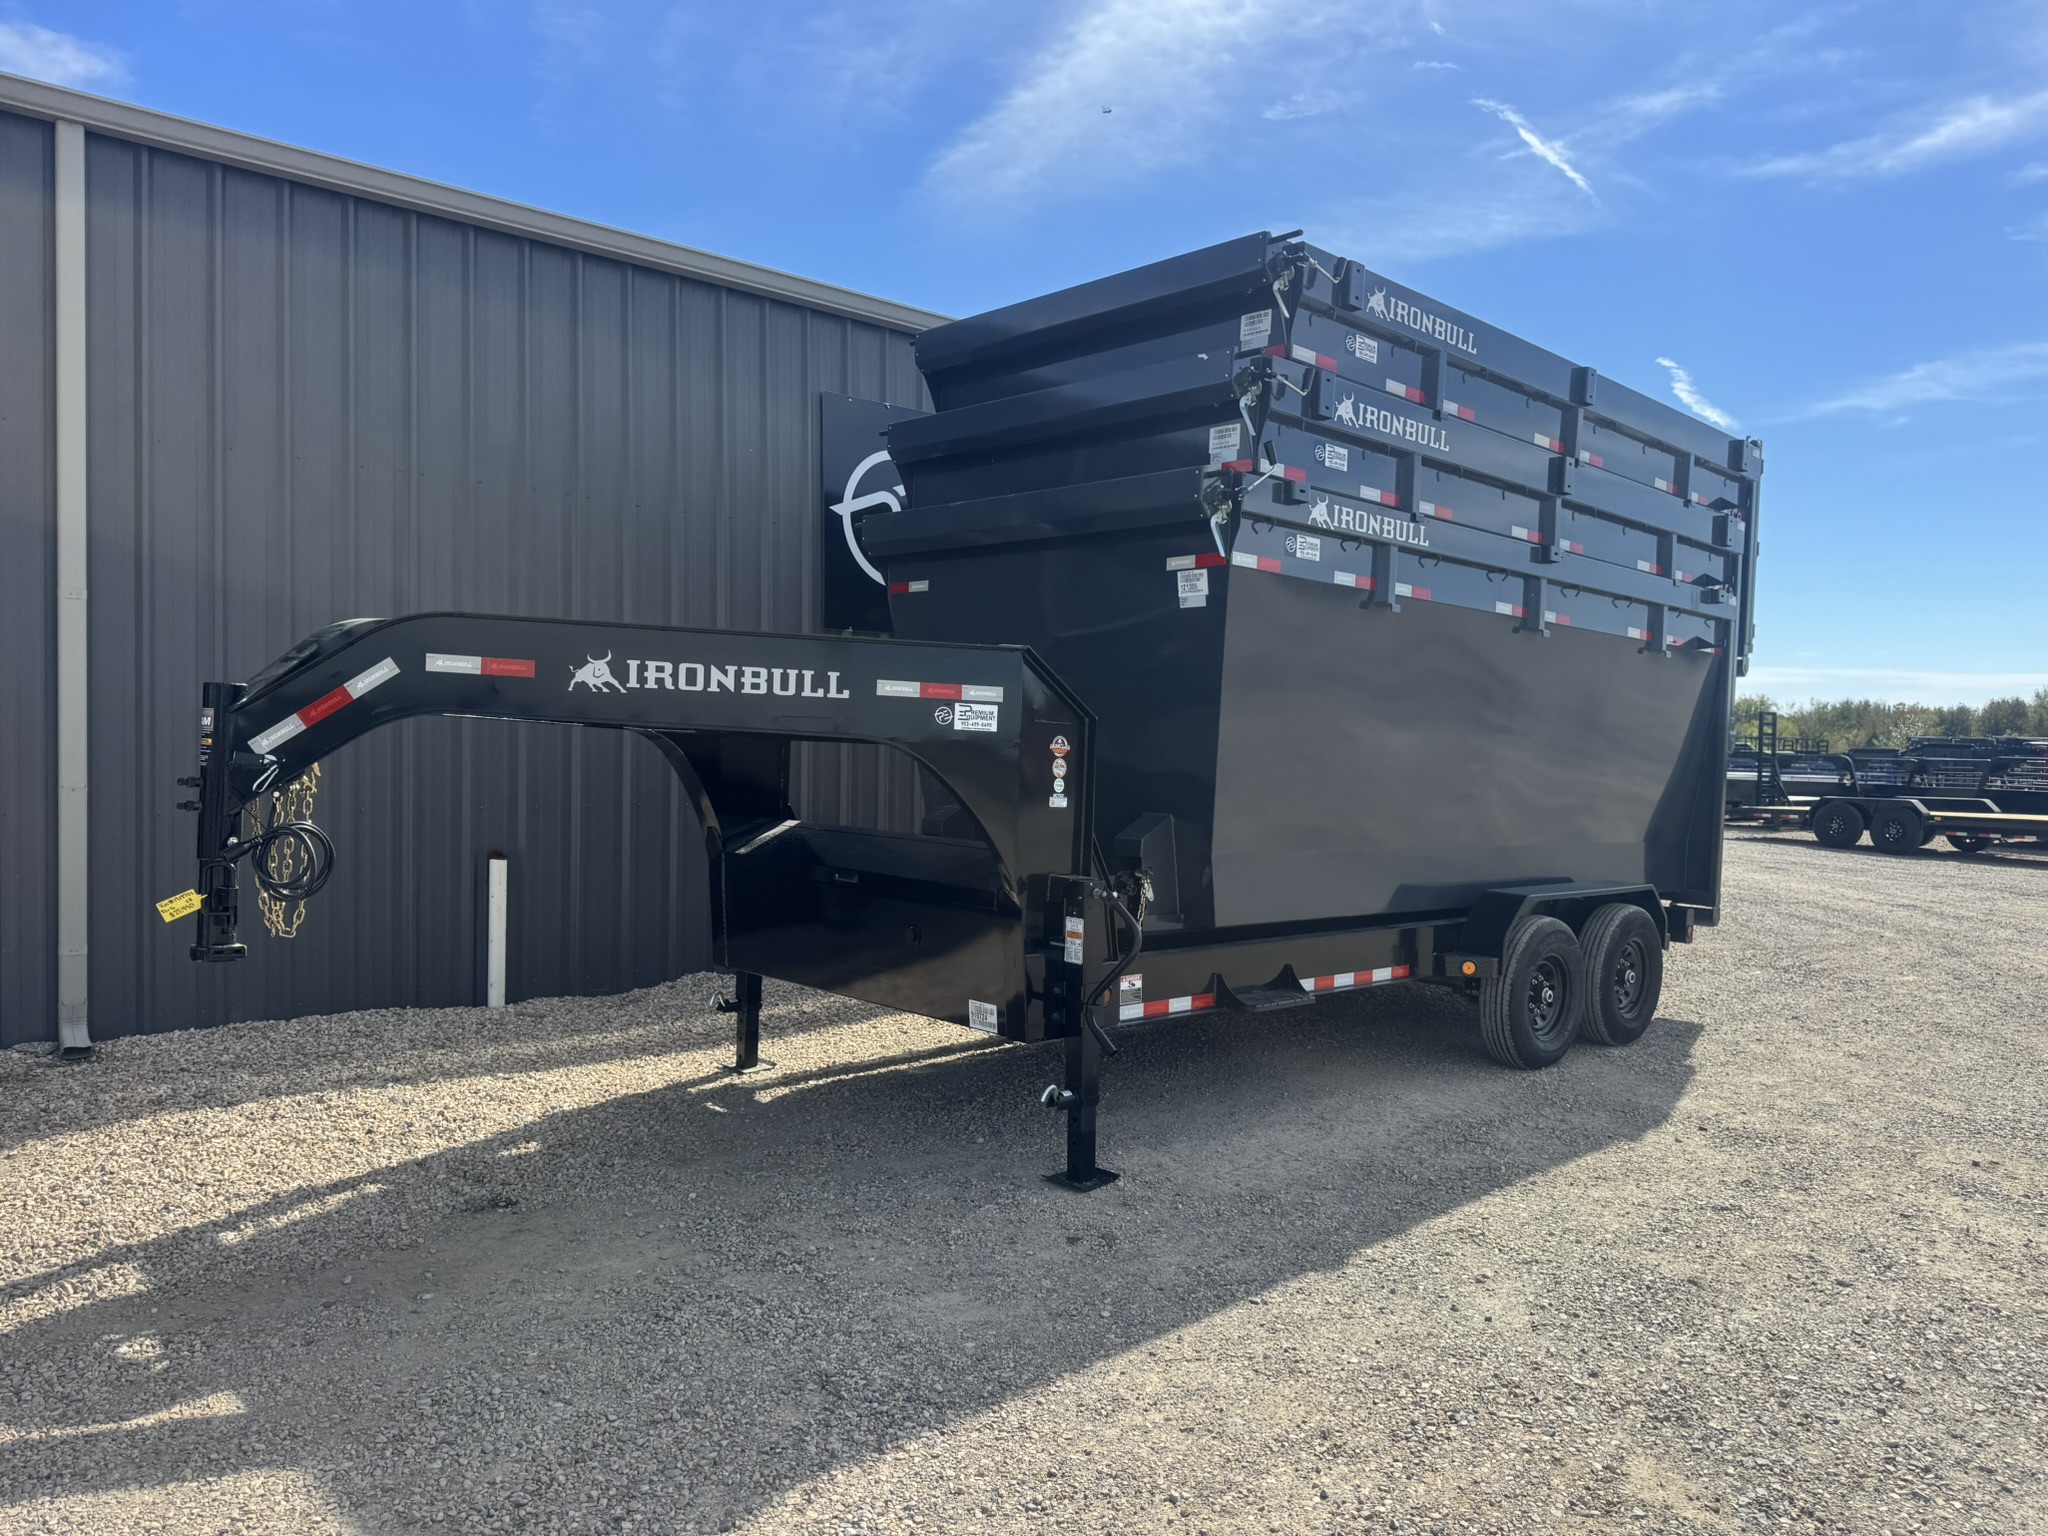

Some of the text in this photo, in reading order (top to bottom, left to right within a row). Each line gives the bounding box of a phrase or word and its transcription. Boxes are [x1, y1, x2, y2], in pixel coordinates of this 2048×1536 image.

[1388, 295, 1478, 355] IRONBULL
[1356, 402, 1450, 453] IRONBULL
[1331, 503, 1430, 548] IRONBULL
[626, 659, 850, 699] IRONBULL
